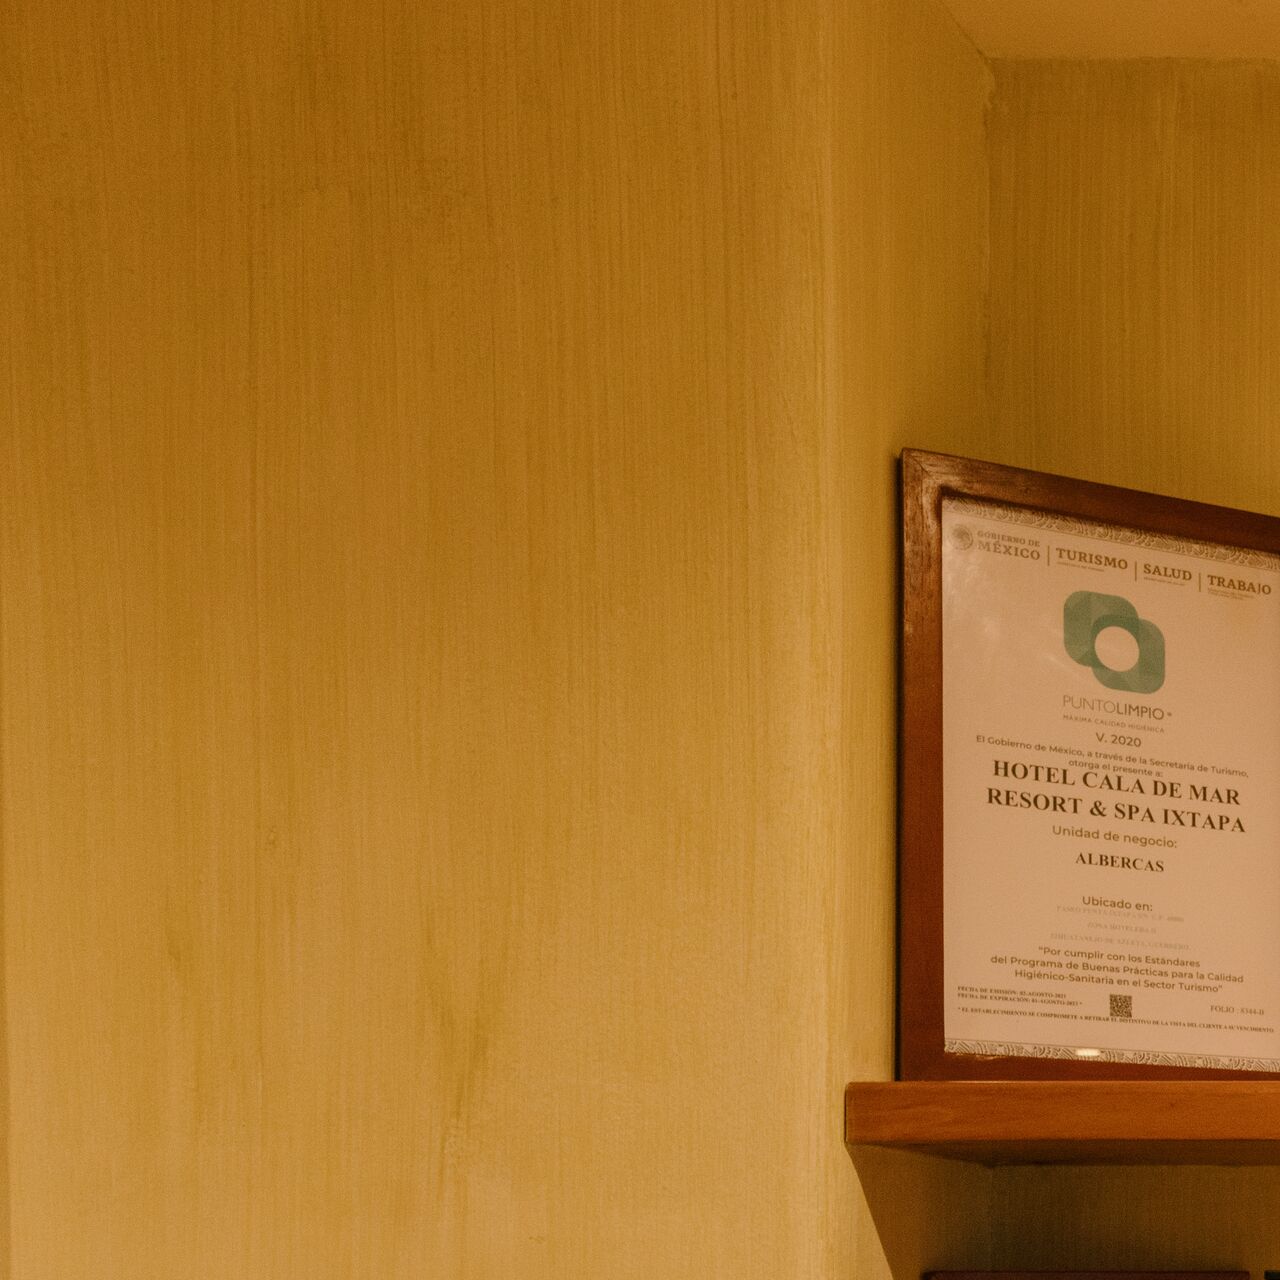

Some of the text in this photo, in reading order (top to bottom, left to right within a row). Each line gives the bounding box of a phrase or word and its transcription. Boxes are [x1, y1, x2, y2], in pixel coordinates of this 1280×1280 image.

[978, 540, 1041, 560] MÉXICO
[1056, 547, 1129, 570] TURISMO
[1143, 564, 1192, 581] SALUD
[1207, 574, 1272, 595] TRABAJO
[1063, 695, 1165, 720] PUNTOLIMPIO
[1096, 733, 1141, 747] V. 2020
[976, 735, 985, 743] El
[987, 736, 1032, 750] Gobierno
[1049, 746, 1085, 757] México,
[1095, 752, 1123, 762] través
[1139, 756, 1147, 765] la
[1197, 764, 1208, 772] de
[1211, 766, 1249, 778] Turismo,
[1068, 760, 1100, 770] otorga
[1113, 765, 1152, 776] presente
[993, 760, 1240, 805] HOTEL CALA DE MAR
[987, 788, 1246, 833] RESORT & SPA IXTAPA
[1052, 825, 1177, 848] Unidad de negocio:
[1075, 852, 1164, 872] ALBERCAS
[1082, 896, 1153, 912] Ubicado en:
[990, 956, 1244, 983] del Programa de Buenas Prácticas para la Calidad
[1064, 950, 1104, 960] cumplir
[1106, 954, 1126, 962] con
[1128, 954, 1142, 963] los
[1145, 956, 1201, 967] Estándares
[1015, 970, 1114, 985] Higiénico-Sanitaria
[1144, 980, 1175, 990] Sector
